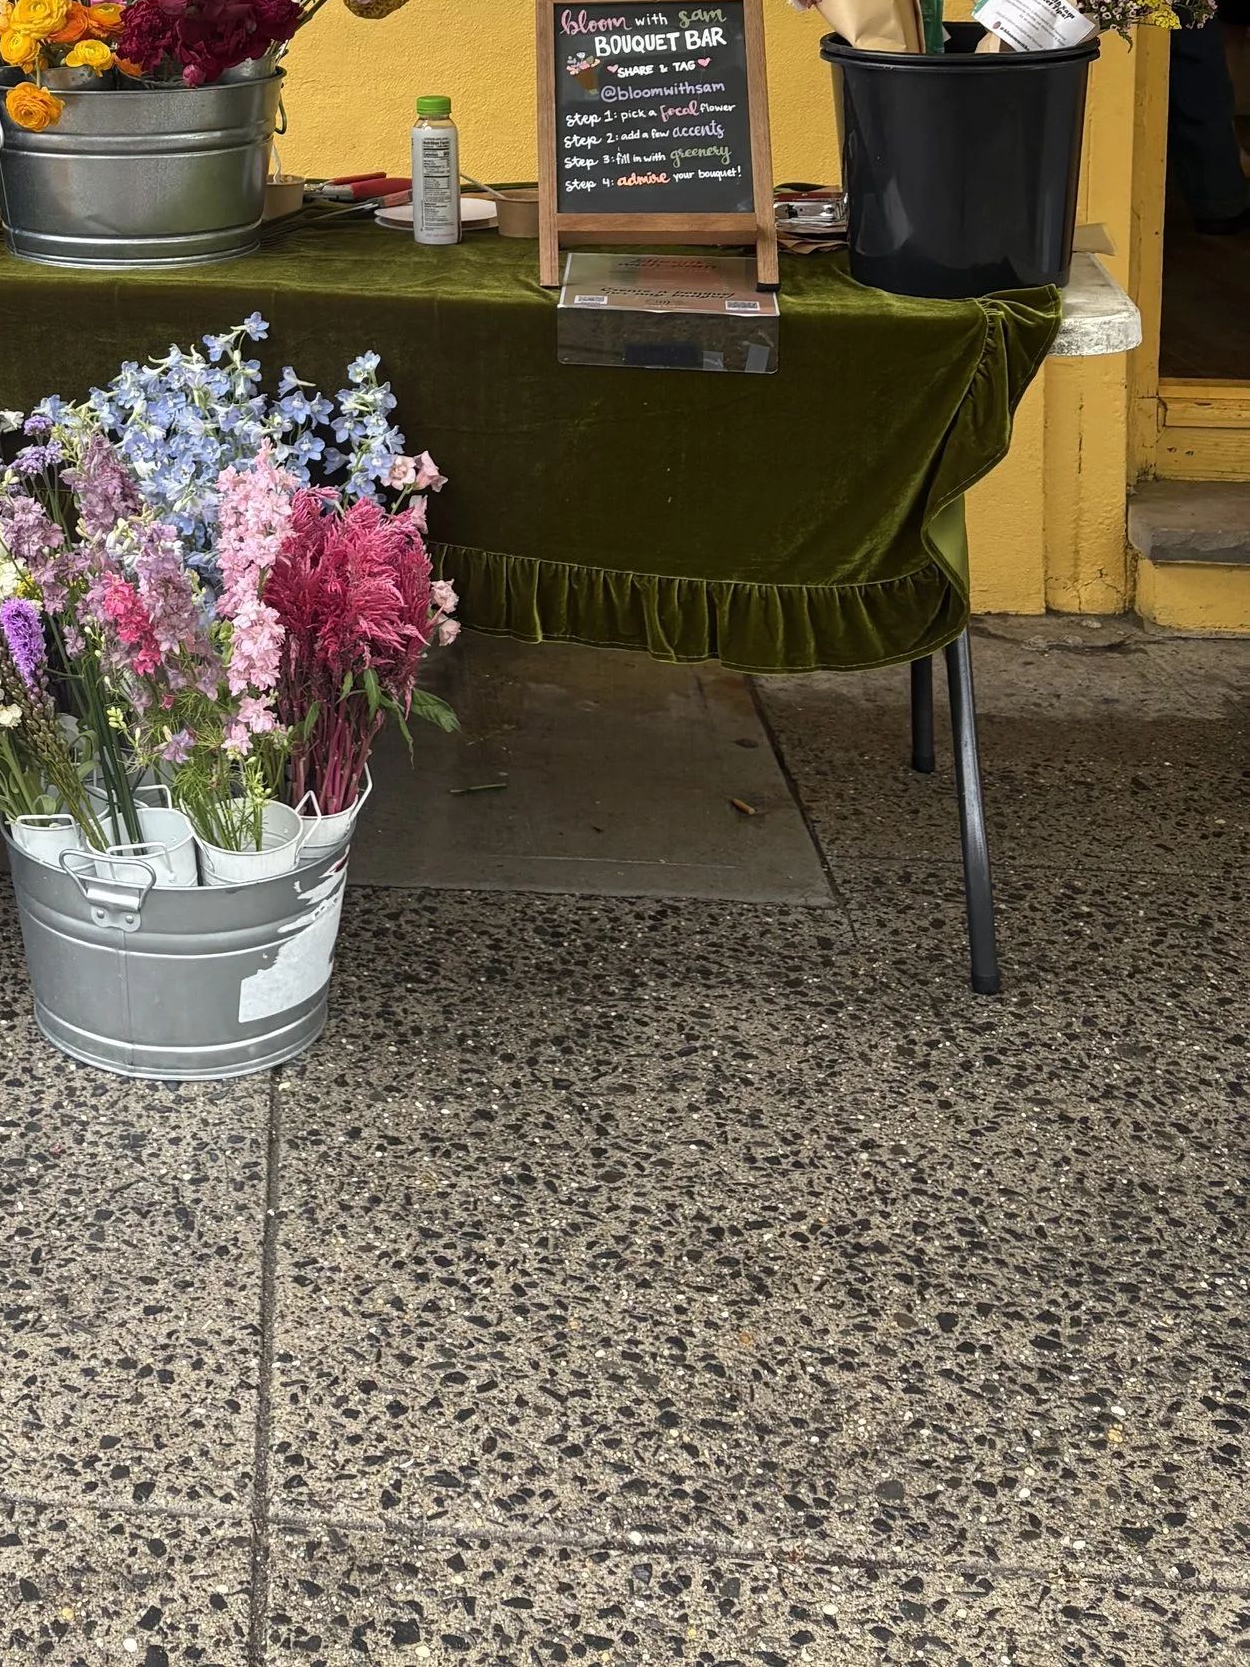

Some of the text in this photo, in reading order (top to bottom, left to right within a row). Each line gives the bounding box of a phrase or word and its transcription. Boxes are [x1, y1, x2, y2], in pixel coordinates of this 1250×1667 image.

[559, 8, 727, 36] bloom with sam
[594, 26, 728, 57] BOUQUET BAR
[617, 60, 696, 78] SHARE & TAG
[601, 80, 726, 103] @bloomwithsam
[565, 100, 736, 127] step 1: pick a focal flower
[563, 133, 602, 149] step
[606, 132, 619, 144] 2:
[620, 130, 641, 141] add
[650, 129, 670, 139] few
[672, 119, 725, 139] accents
[563, 156, 599, 171] step
[615, 152, 631, 165] fill
[632, 153, 643, 163] in
[643, 151, 667, 163] with
[670, 145, 732, 168] greenery
[565, 165, 743, 193] step 4: admire your bouquet!
